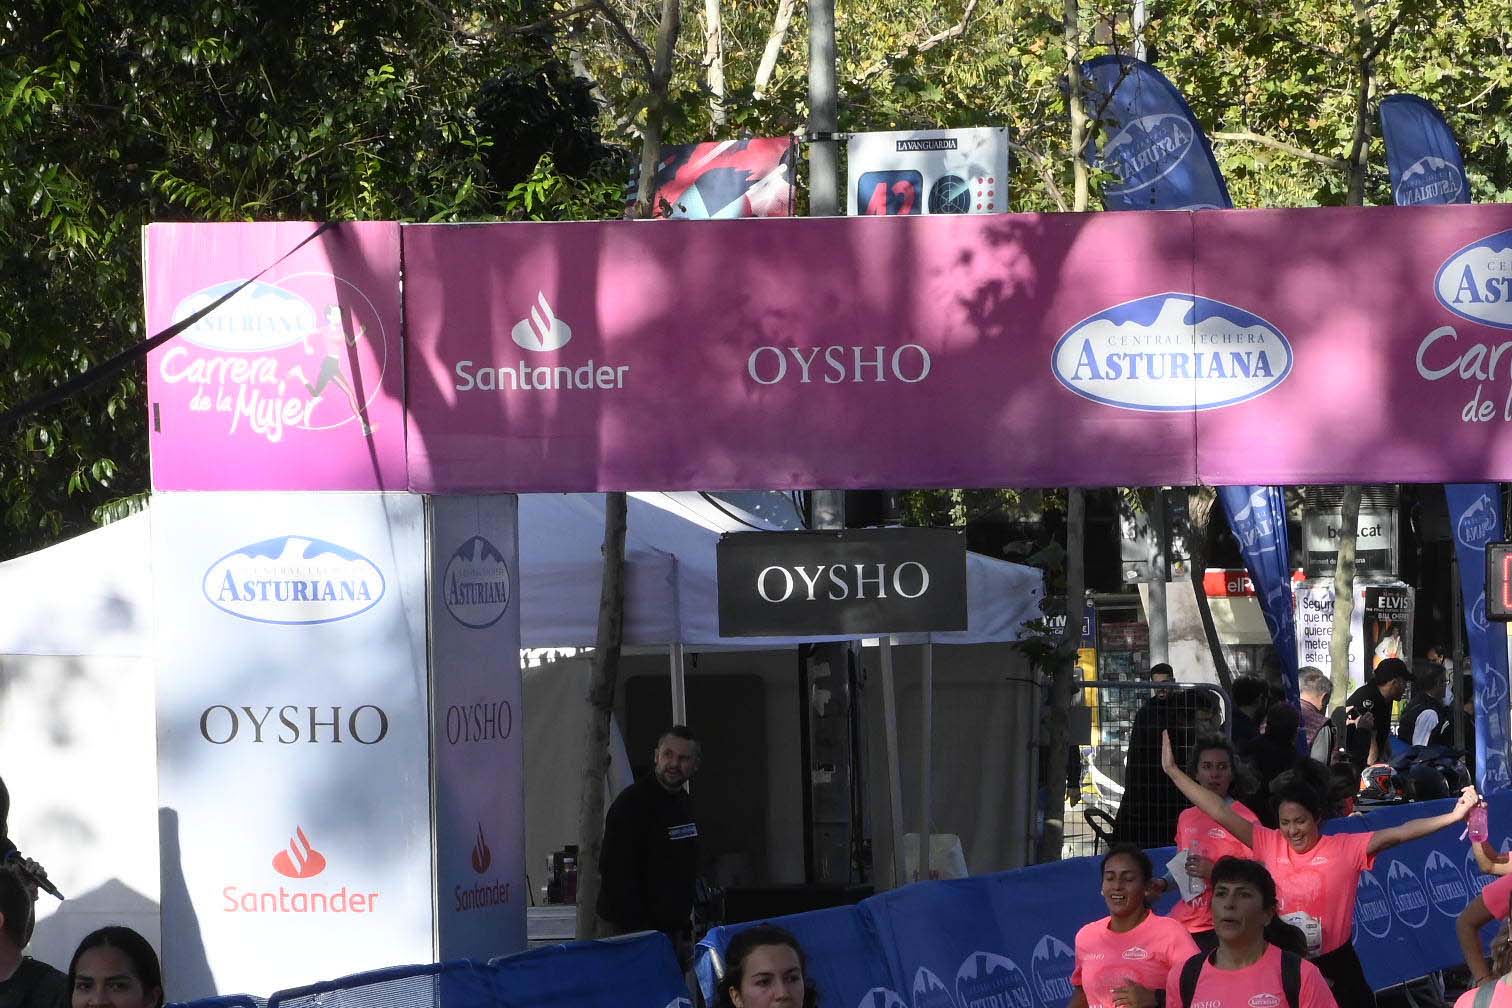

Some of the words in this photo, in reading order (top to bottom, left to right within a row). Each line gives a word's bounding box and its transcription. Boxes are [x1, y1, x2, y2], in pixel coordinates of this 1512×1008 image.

[1107, 333, 1184, 346] CENTRAL
[1192, 332, 1265, 345] LECHERA
[160, 346, 279, 385] Carrera
[454, 359, 631, 392] Santander
[747, 343, 933, 386] OYSHO
[1071, 340, 1274, 384] ASTURIANA
[189, 385, 213, 412] de
[216, 384, 232, 413] la
[229, 380, 323, 443] Mujer
[1461, 385, 1496, 422] de
[216, 568, 372, 603] ASTURIANA
[447, 570, 507, 607] ASTURIANA
[756, 560, 931, 603] OYSHO
[1377, 596, 1409, 609] ELVIS
[199, 703, 390, 745] OYSHO
[444, 701, 514, 748] OYSHO
[221, 886, 380, 914] Santander
[453, 882, 512, 913] Santander
